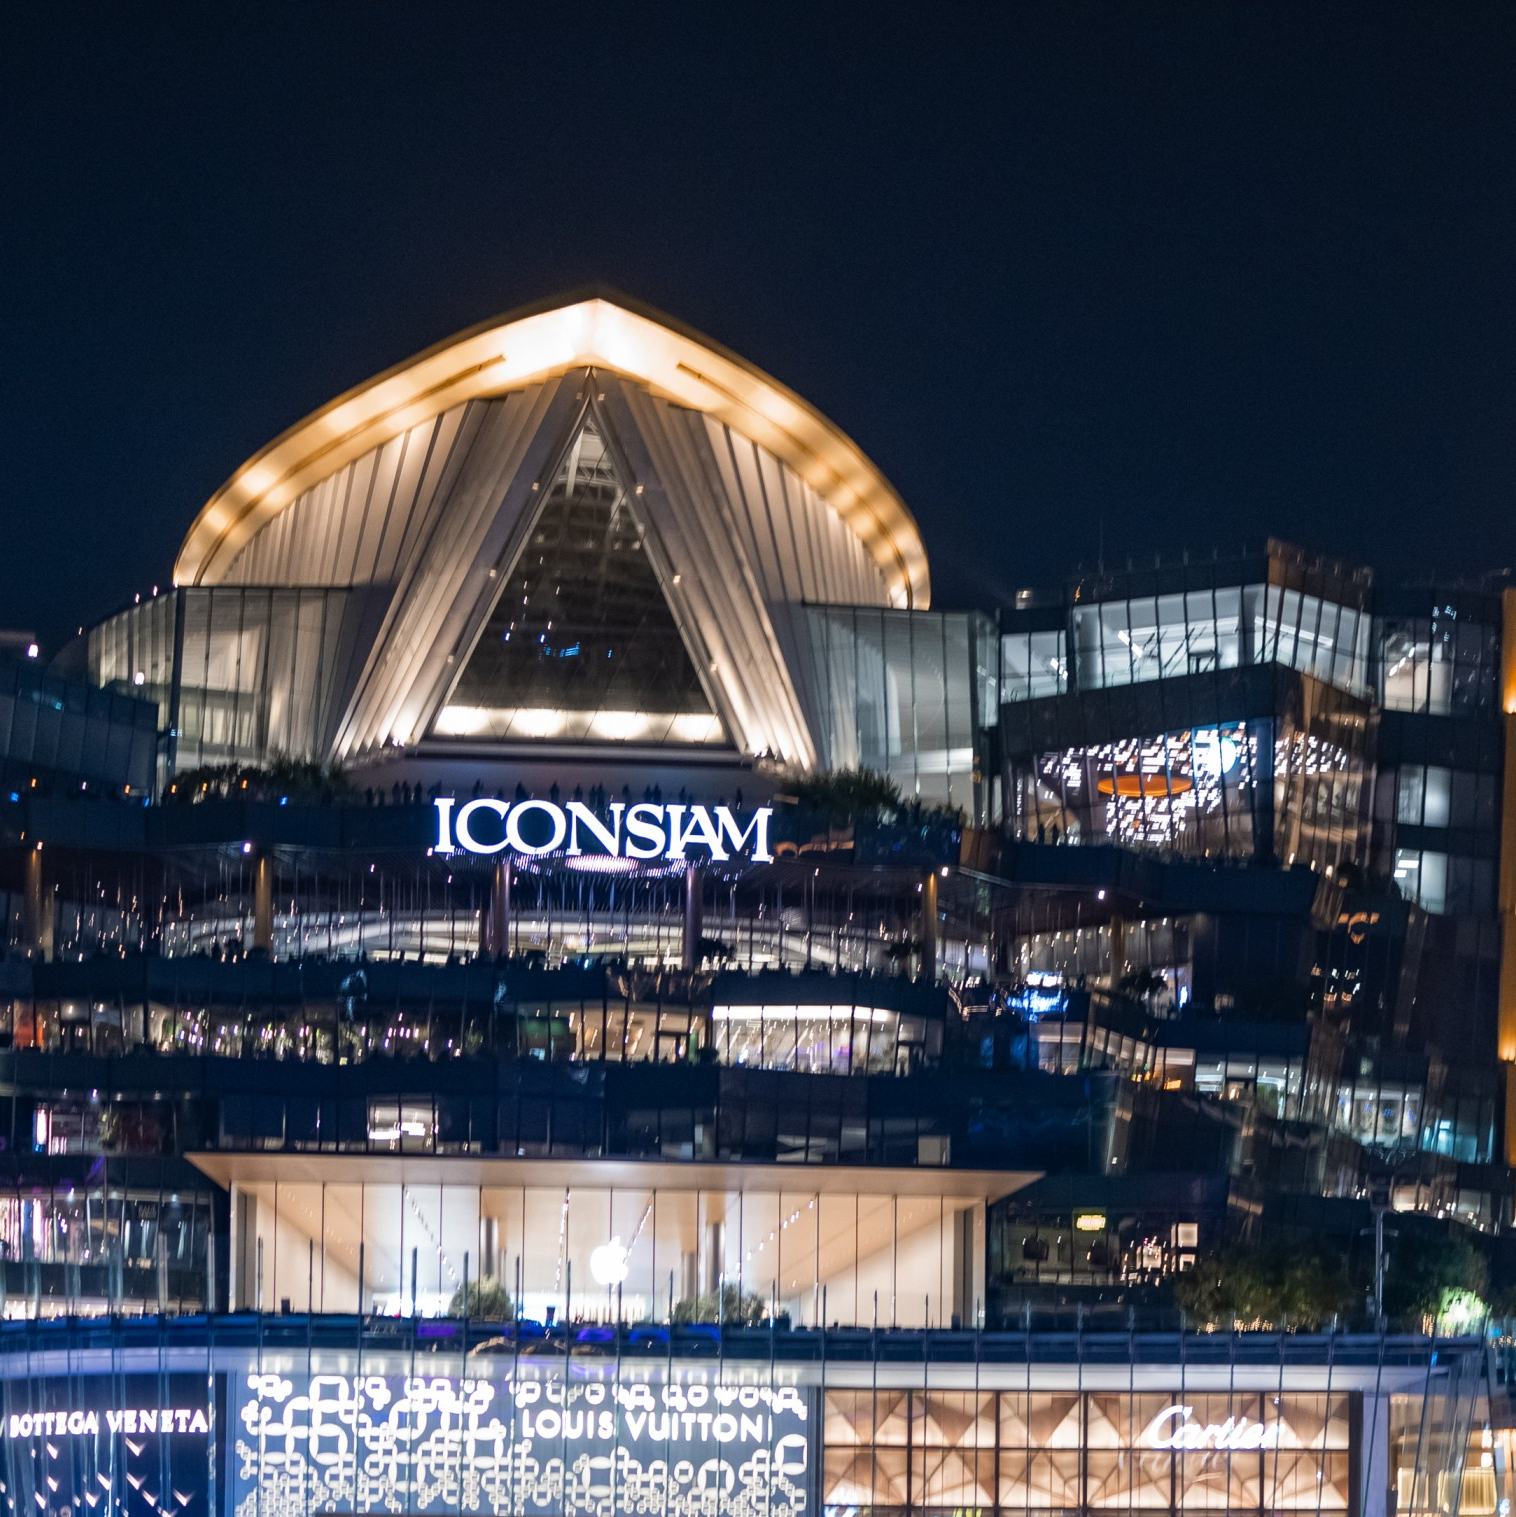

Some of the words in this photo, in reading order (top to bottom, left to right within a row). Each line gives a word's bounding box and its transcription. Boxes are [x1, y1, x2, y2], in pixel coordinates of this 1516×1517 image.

[434, 797, 774, 862] ICONSIAM
[9, 1411, 99, 1438] BOTTEGA
[106, 1409, 209, 1434] VENETA
[522, 1410, 614, 1440] LOUIS
[627, 1411, 764, 1444] VUITTON
[1147, 1404, 1287, 1450] Cartier
